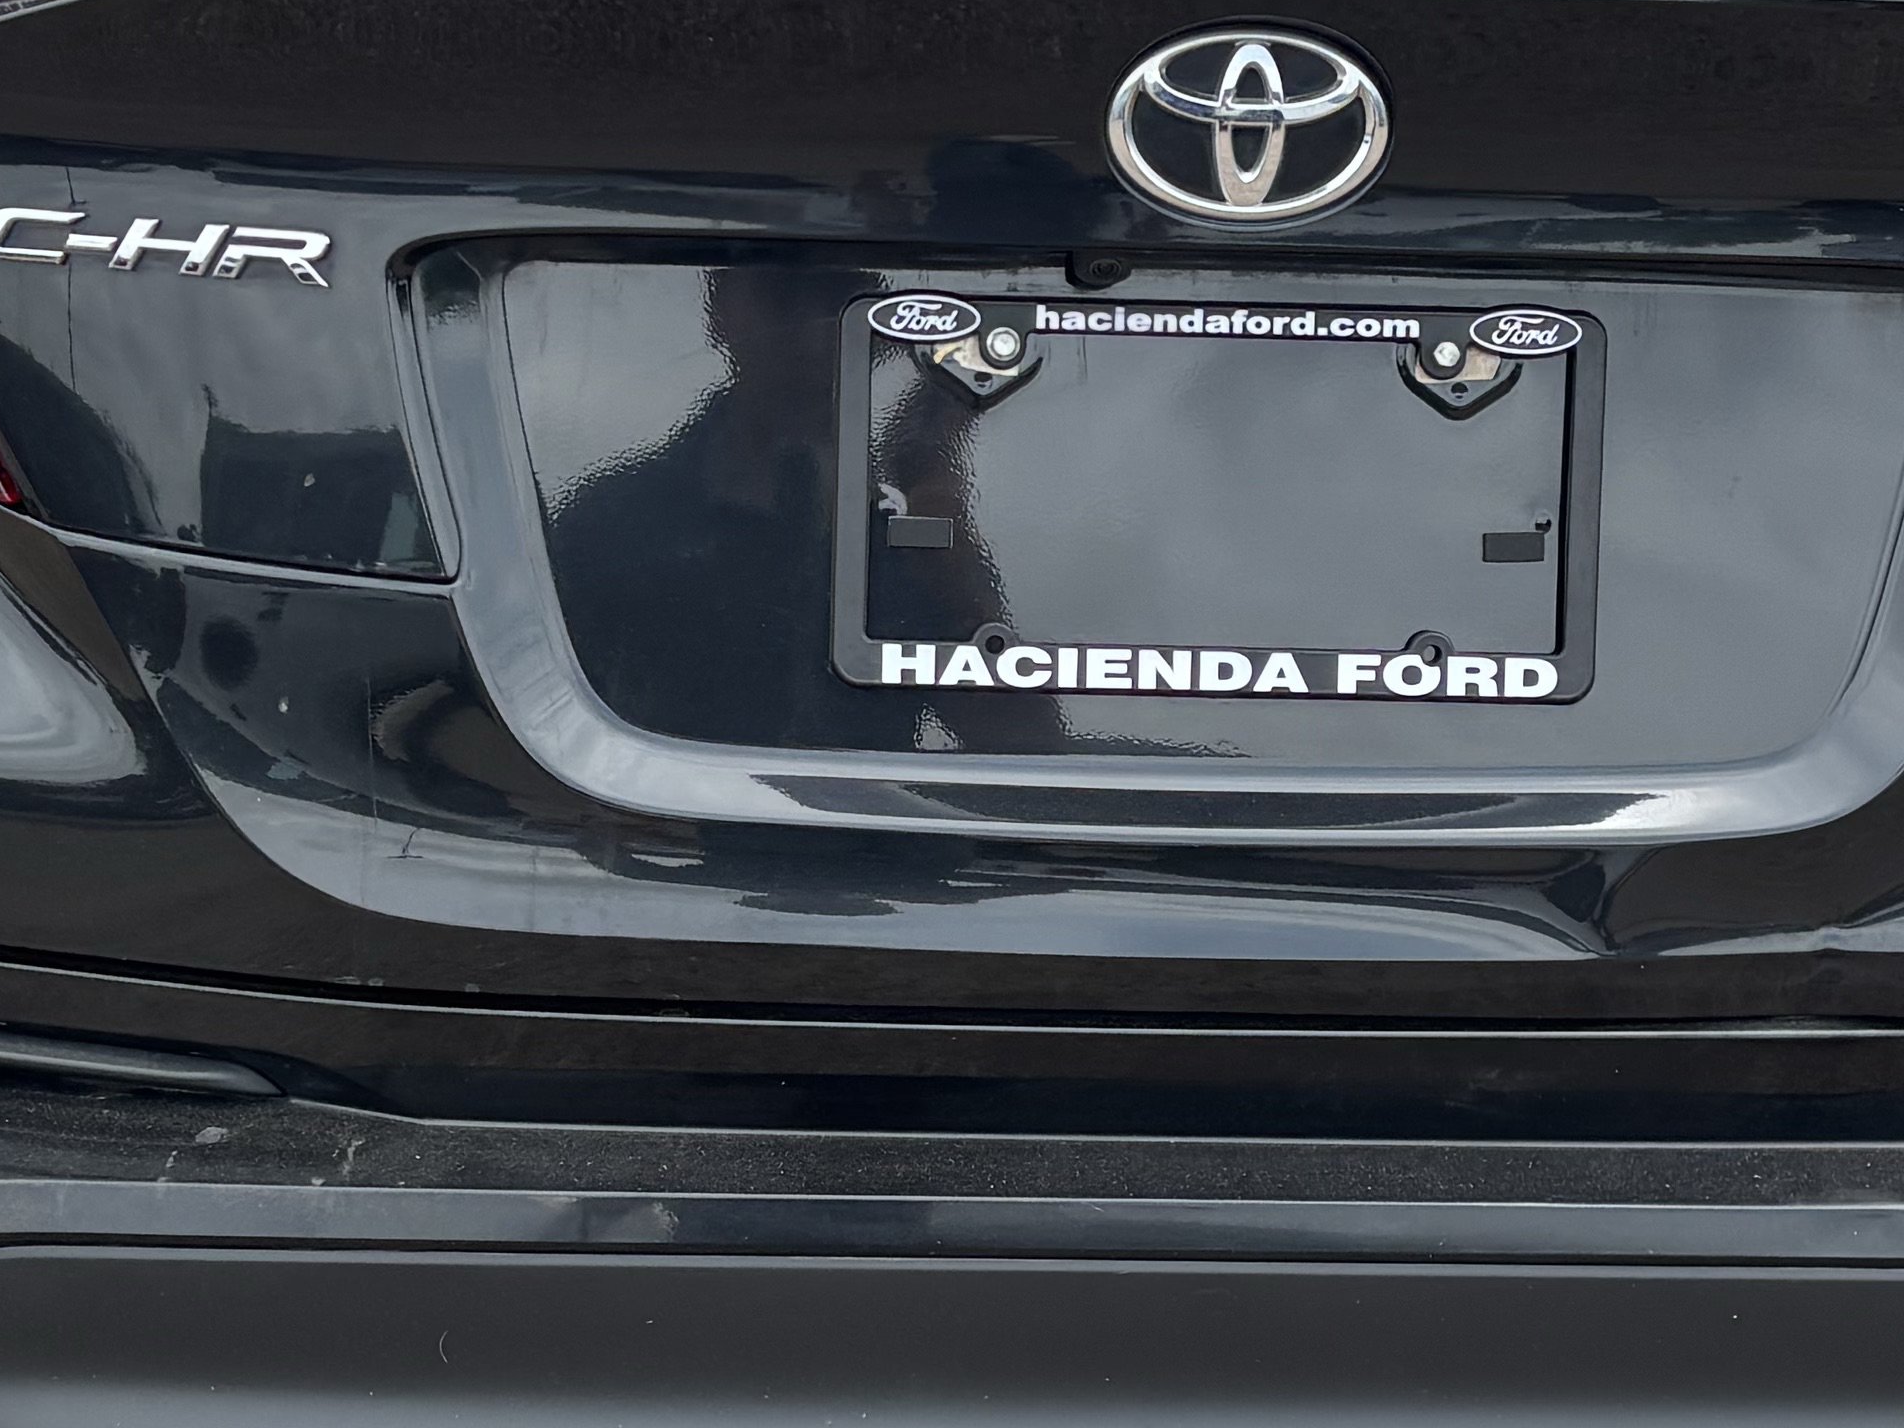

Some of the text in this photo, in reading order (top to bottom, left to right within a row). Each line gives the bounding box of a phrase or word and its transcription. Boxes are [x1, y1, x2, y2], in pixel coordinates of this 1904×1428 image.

[890, 303, 957, 332] Ford
[1035, 304, 1420, 339] haciendaford.com
[1491, 315, 1560, 347] Ford
[880, 643, 1560, 699] HACIENDA FORD
